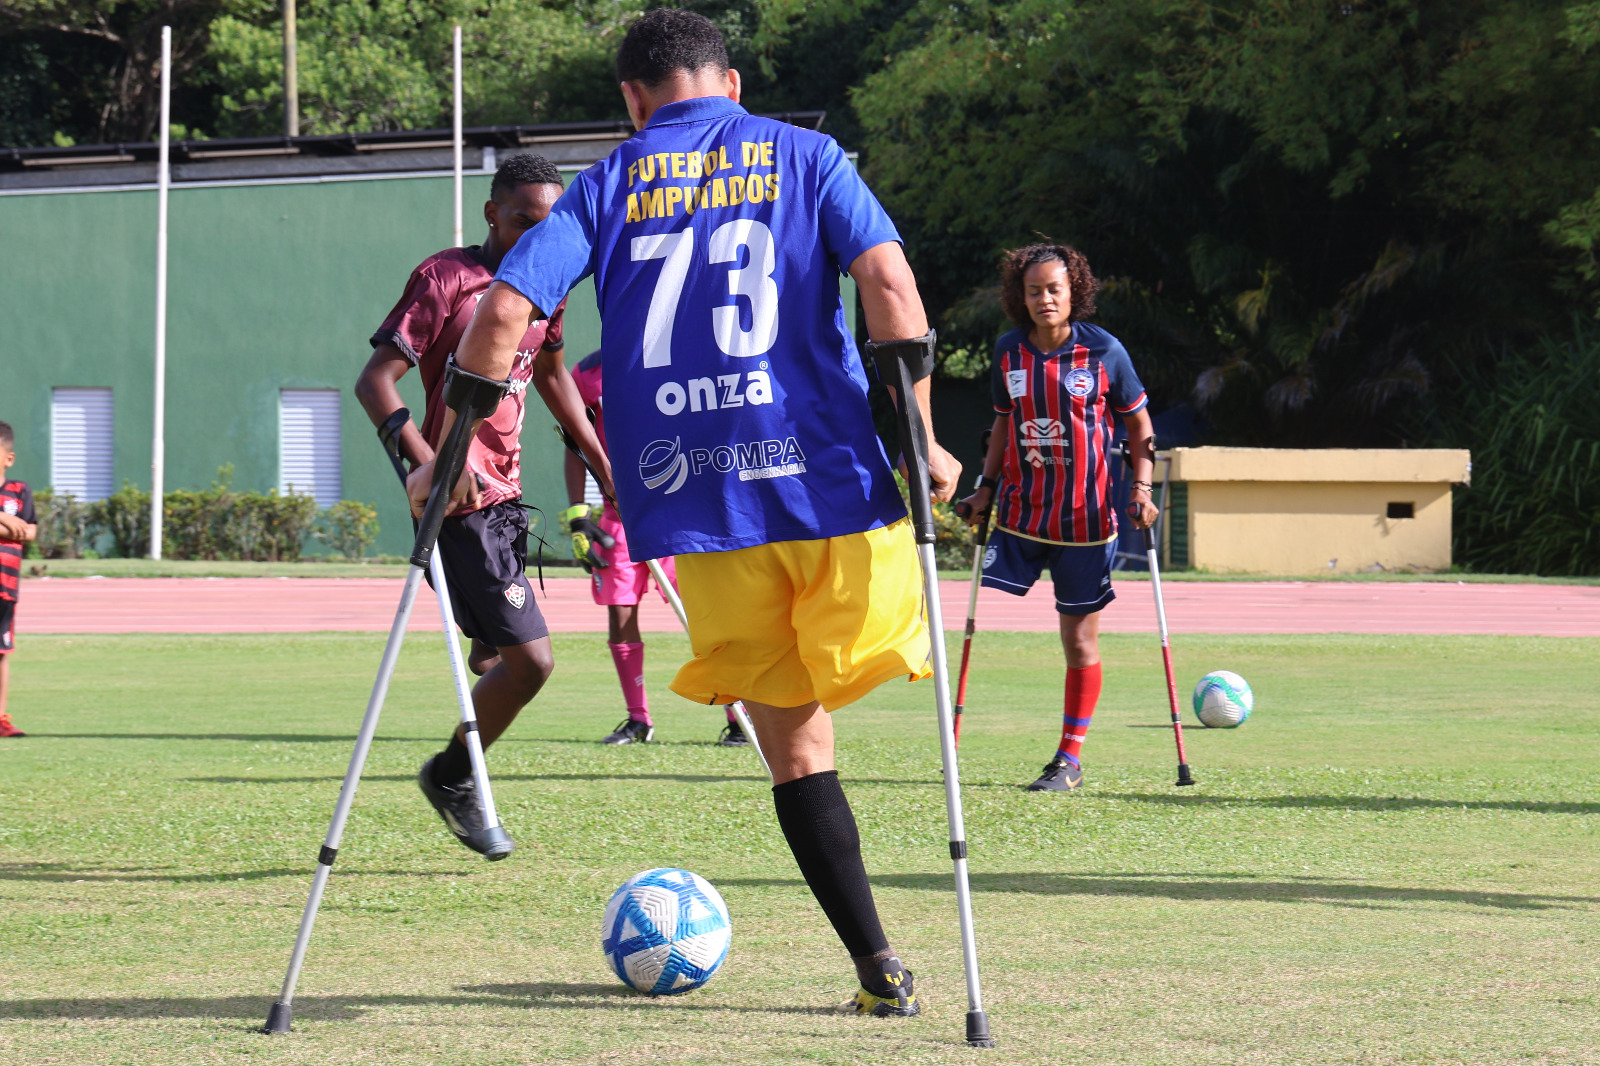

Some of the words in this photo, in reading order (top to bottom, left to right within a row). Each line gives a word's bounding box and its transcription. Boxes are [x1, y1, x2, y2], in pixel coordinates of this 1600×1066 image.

[627, 145, 733, 189] FUTEBOL
[741, 141, 775, 168] DE
[625, 173, 780, 224] AMPUTADOS
[630, 218, 779, 369] 73
[655, 370, 774, 416] onza
[689, 436, 807, 476] POMPA
[738, 462, 807, 482] ENGENHARIA
